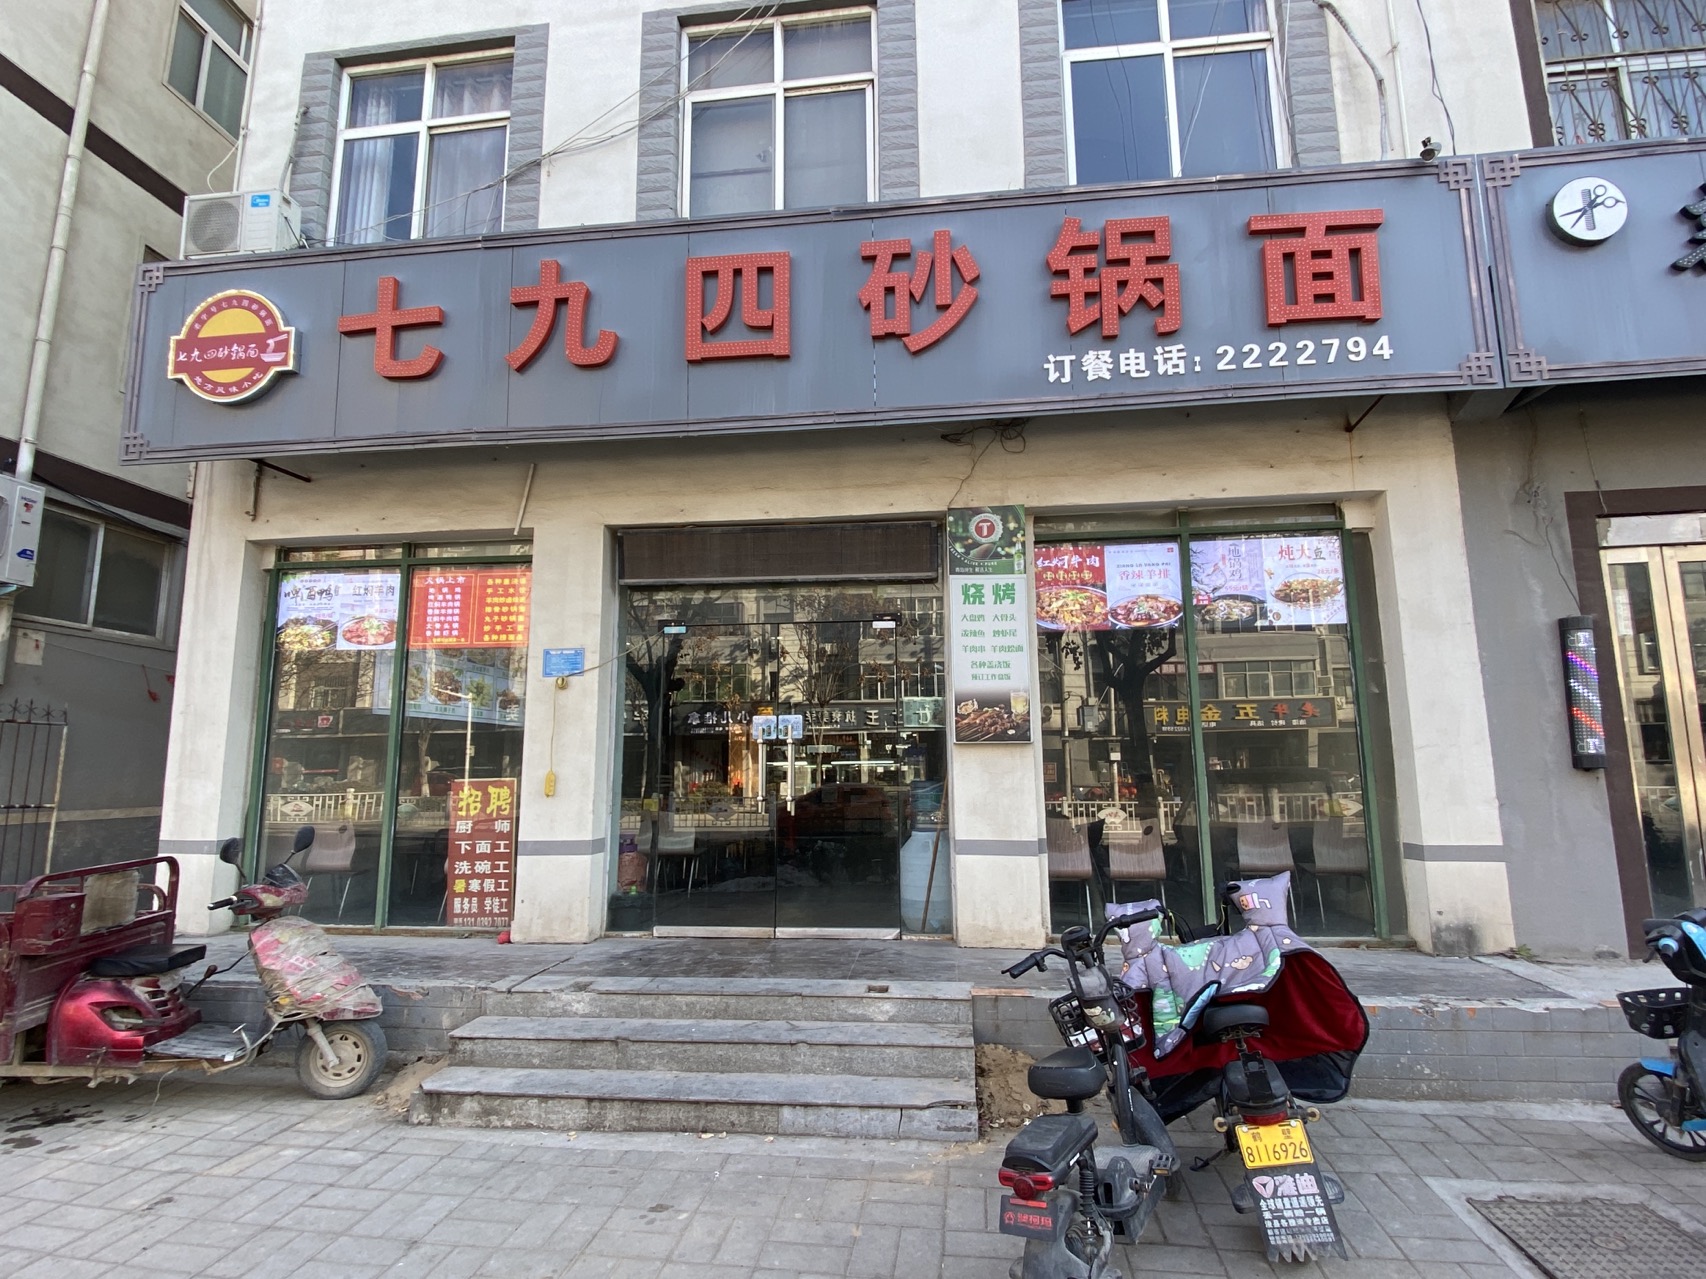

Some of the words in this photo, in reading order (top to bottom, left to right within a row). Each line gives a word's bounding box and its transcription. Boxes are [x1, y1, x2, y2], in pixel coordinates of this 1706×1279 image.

[338, 208, 1384, 380] 七九四砂锅面
[1036, 555, 1100, 568] 红焖牛肉
[961, 582, 1016, 605] 烧烤
[457, 784, 513, 817] 招聘
[455, 820, 510, 834] 厨师
[455, 840, 510, 854] 下面工
[454, 860, 510, 874] 洗碗工
[453, 878, 509, 893] 暑寒假工
[453, 897, 478, 914] 服务员
[484, 897, 508, 914] 学徒工
[1246, 1141, 1308, 1163] 8116926
[1274, 1172, 1320, 1196] 雅迪
